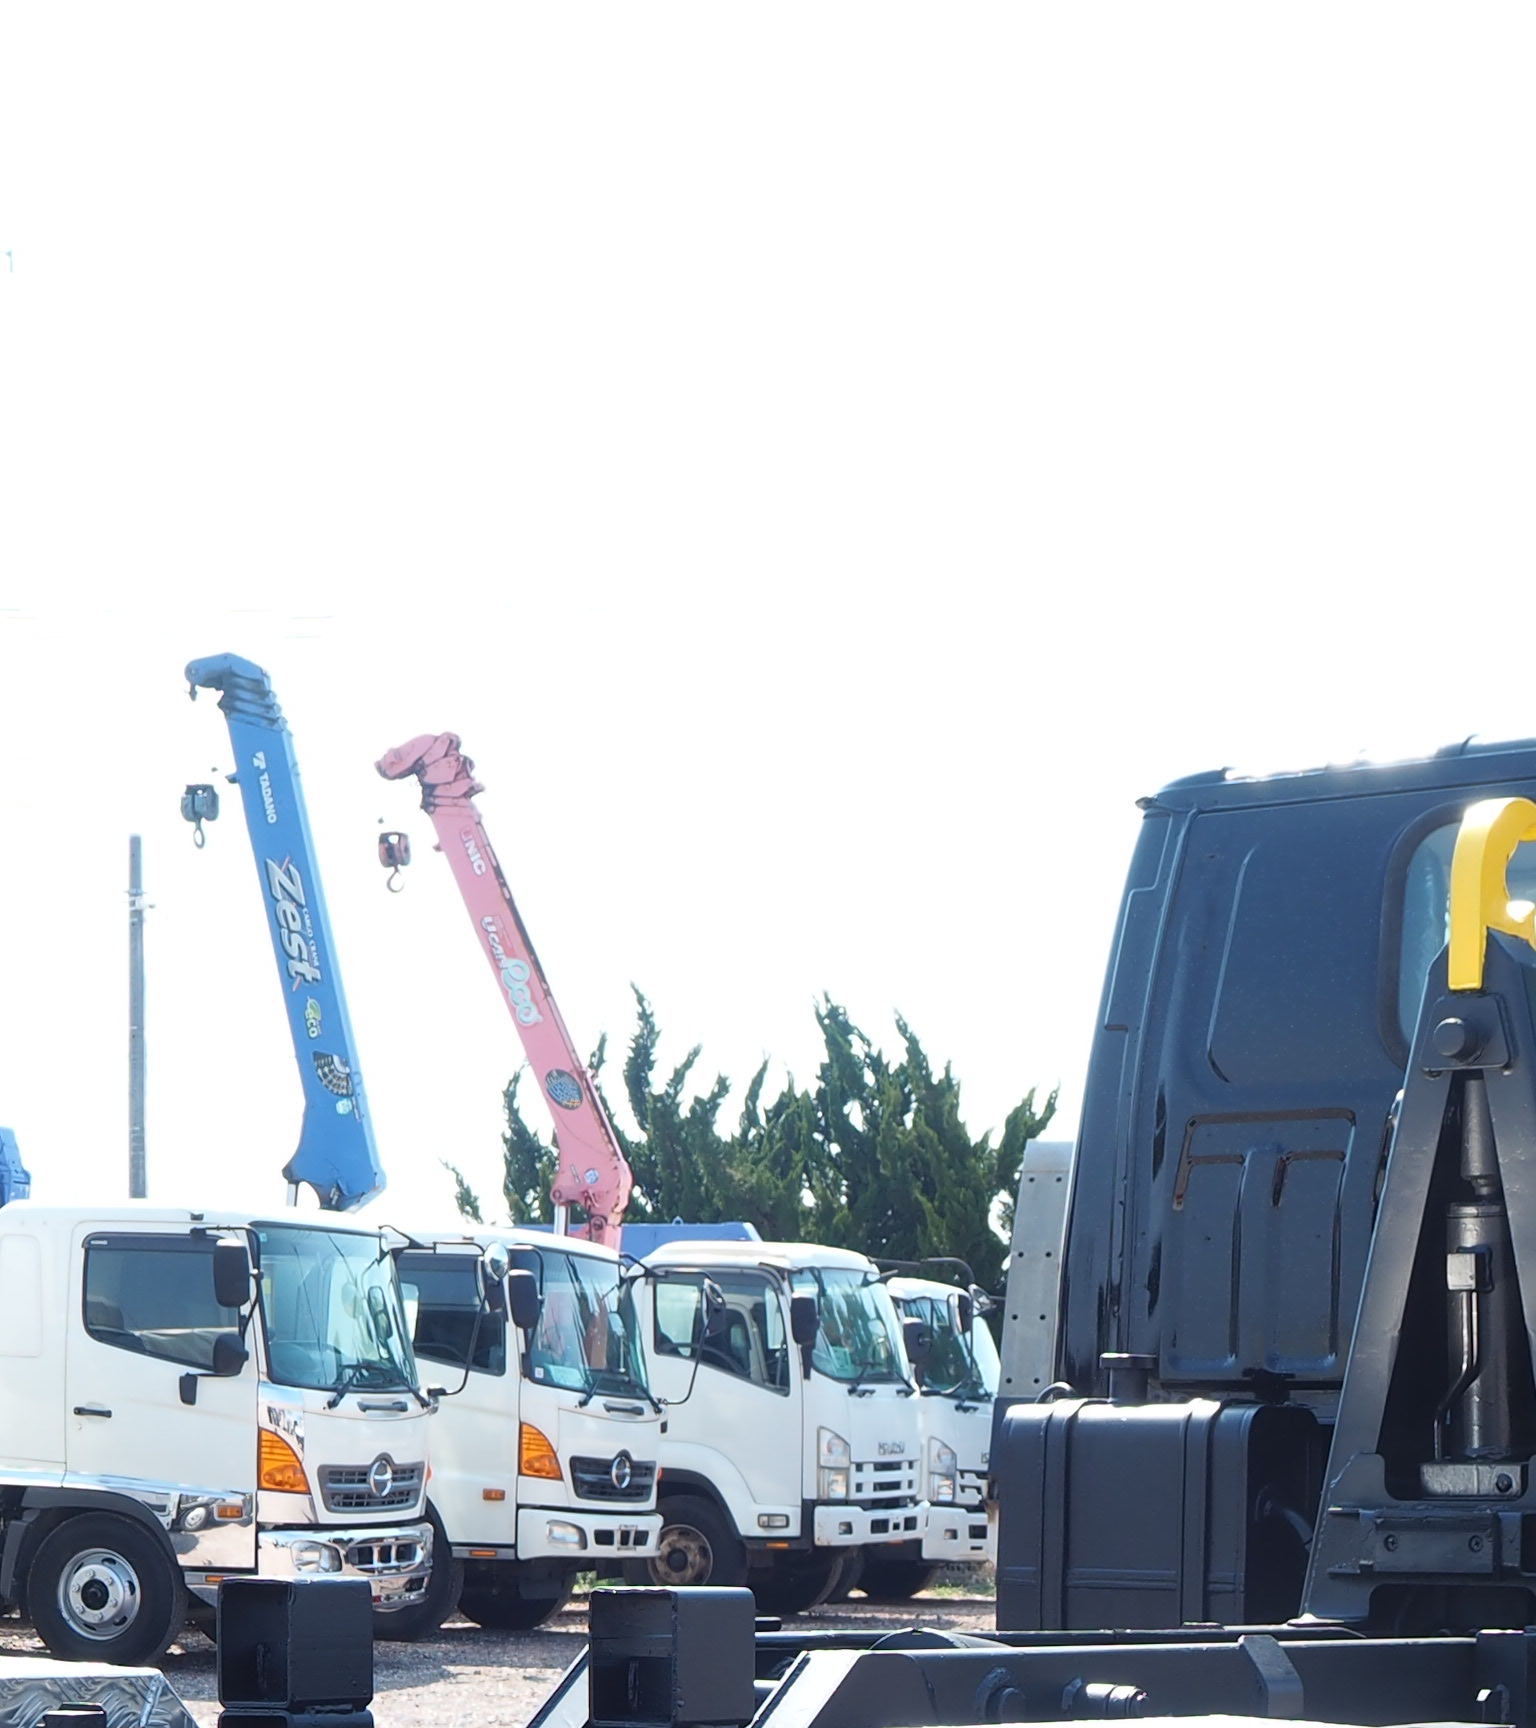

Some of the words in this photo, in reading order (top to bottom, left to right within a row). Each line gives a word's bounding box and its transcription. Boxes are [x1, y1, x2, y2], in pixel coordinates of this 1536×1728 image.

[258, 772, 278, 825] TADANO
[459, 827, 487, 878] UNIC
[266, 856, 322, 987] Zest
[305, 1008, 320, 1040] eco
